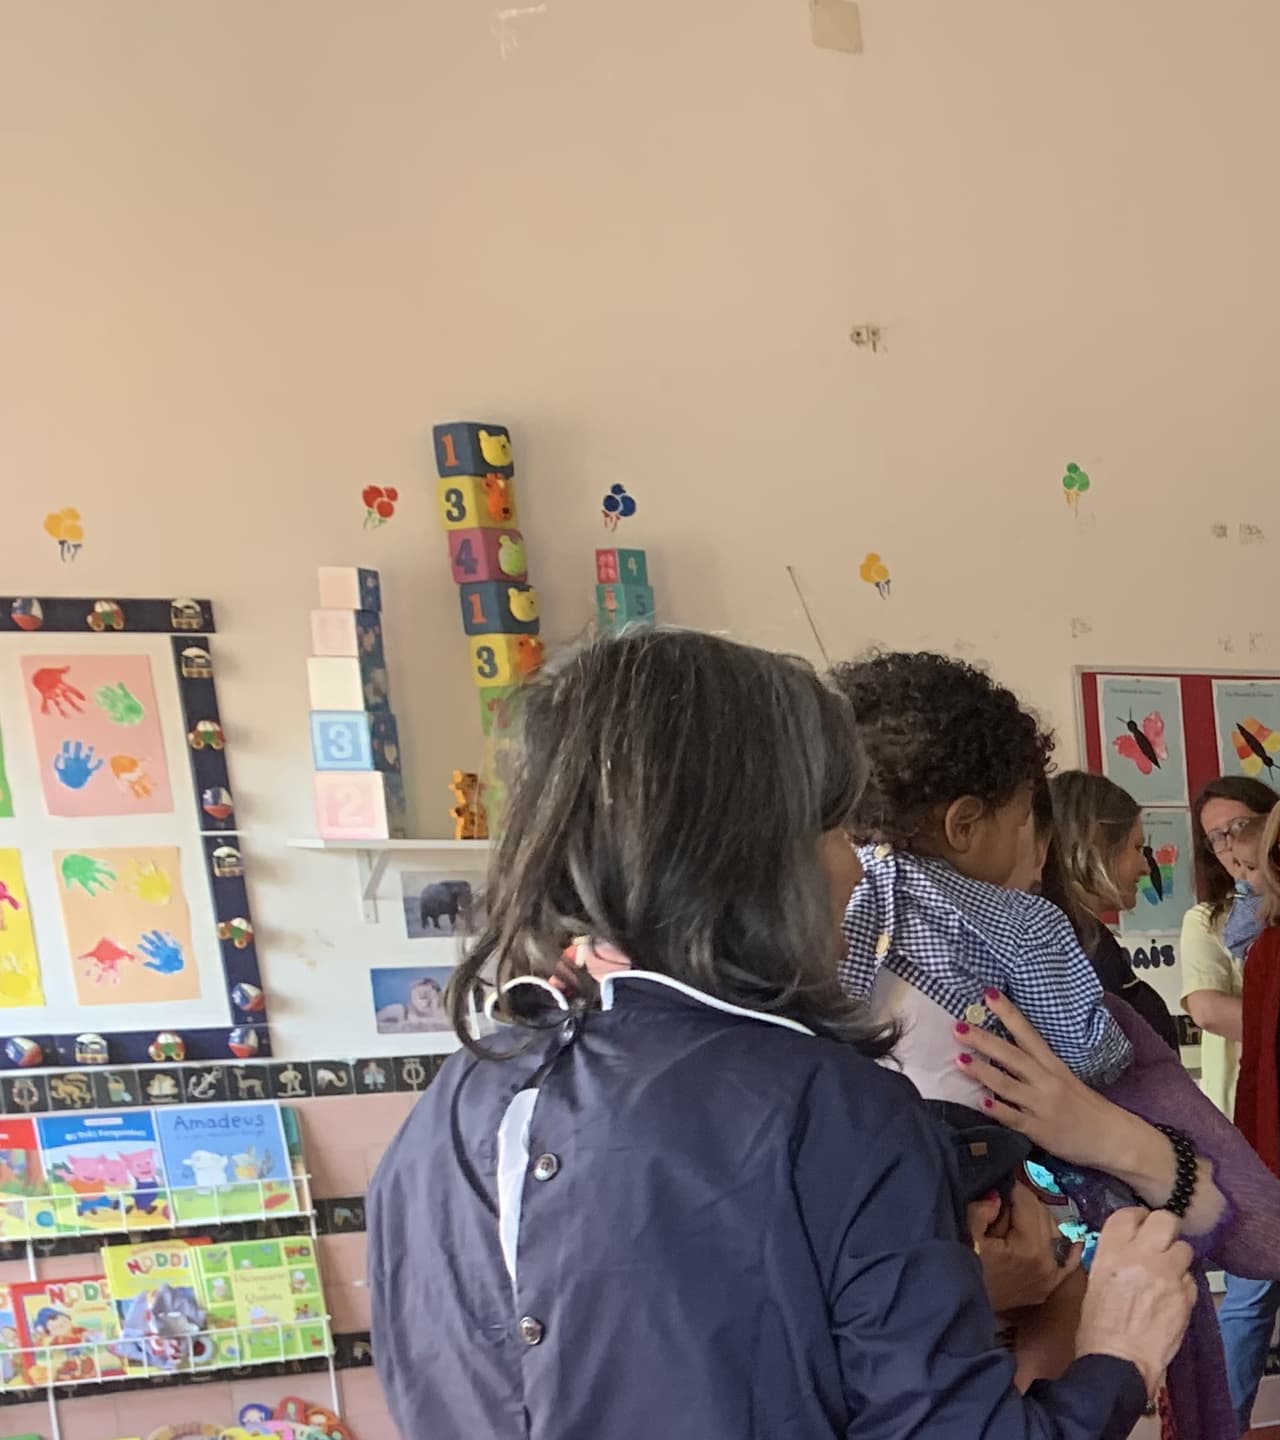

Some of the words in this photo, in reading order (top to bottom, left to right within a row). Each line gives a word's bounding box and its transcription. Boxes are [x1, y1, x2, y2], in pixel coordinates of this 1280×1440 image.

[442, 434, 459, 466] 1
[445, 488, 467, 522] 3
[456, 538, 478, 574] 4
[466, 593, 487, 624] 1
[476, 645, 498, 679] 3
[329, 724, 353, 759] 3
[174, 1112, 266, 1131] Amadeus
